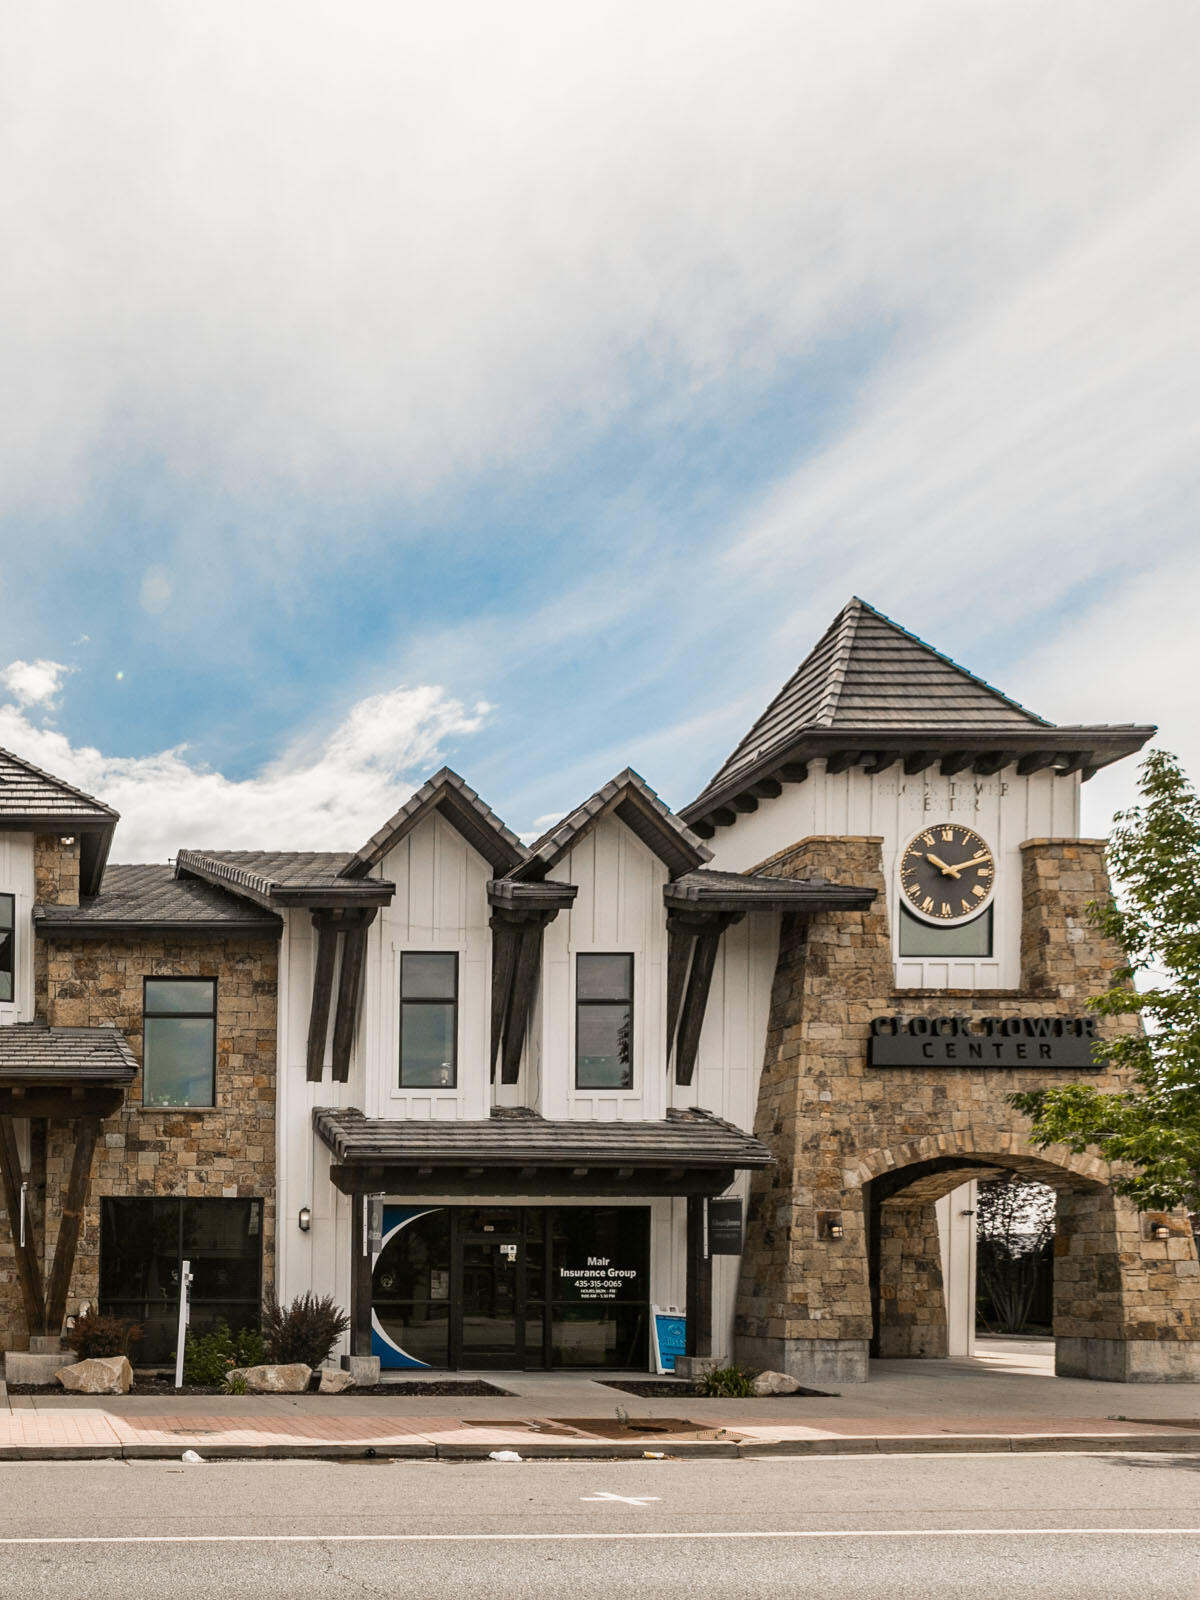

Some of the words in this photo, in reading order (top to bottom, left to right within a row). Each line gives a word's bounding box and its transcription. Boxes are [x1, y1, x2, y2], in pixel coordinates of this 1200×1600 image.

[872, 1016, 972, 1037] CLOCK
[982, 1017, 1097, 1038] TOWER
[923, 1042, 1052, 1060] CENTER
[587, 1256, 611, 1266] Mair
[560, 1268, 606, 1277] Insurance
[607, 1268, 637, 1279] Group
[574, 1280, 623, 1288] 435-315-0065
